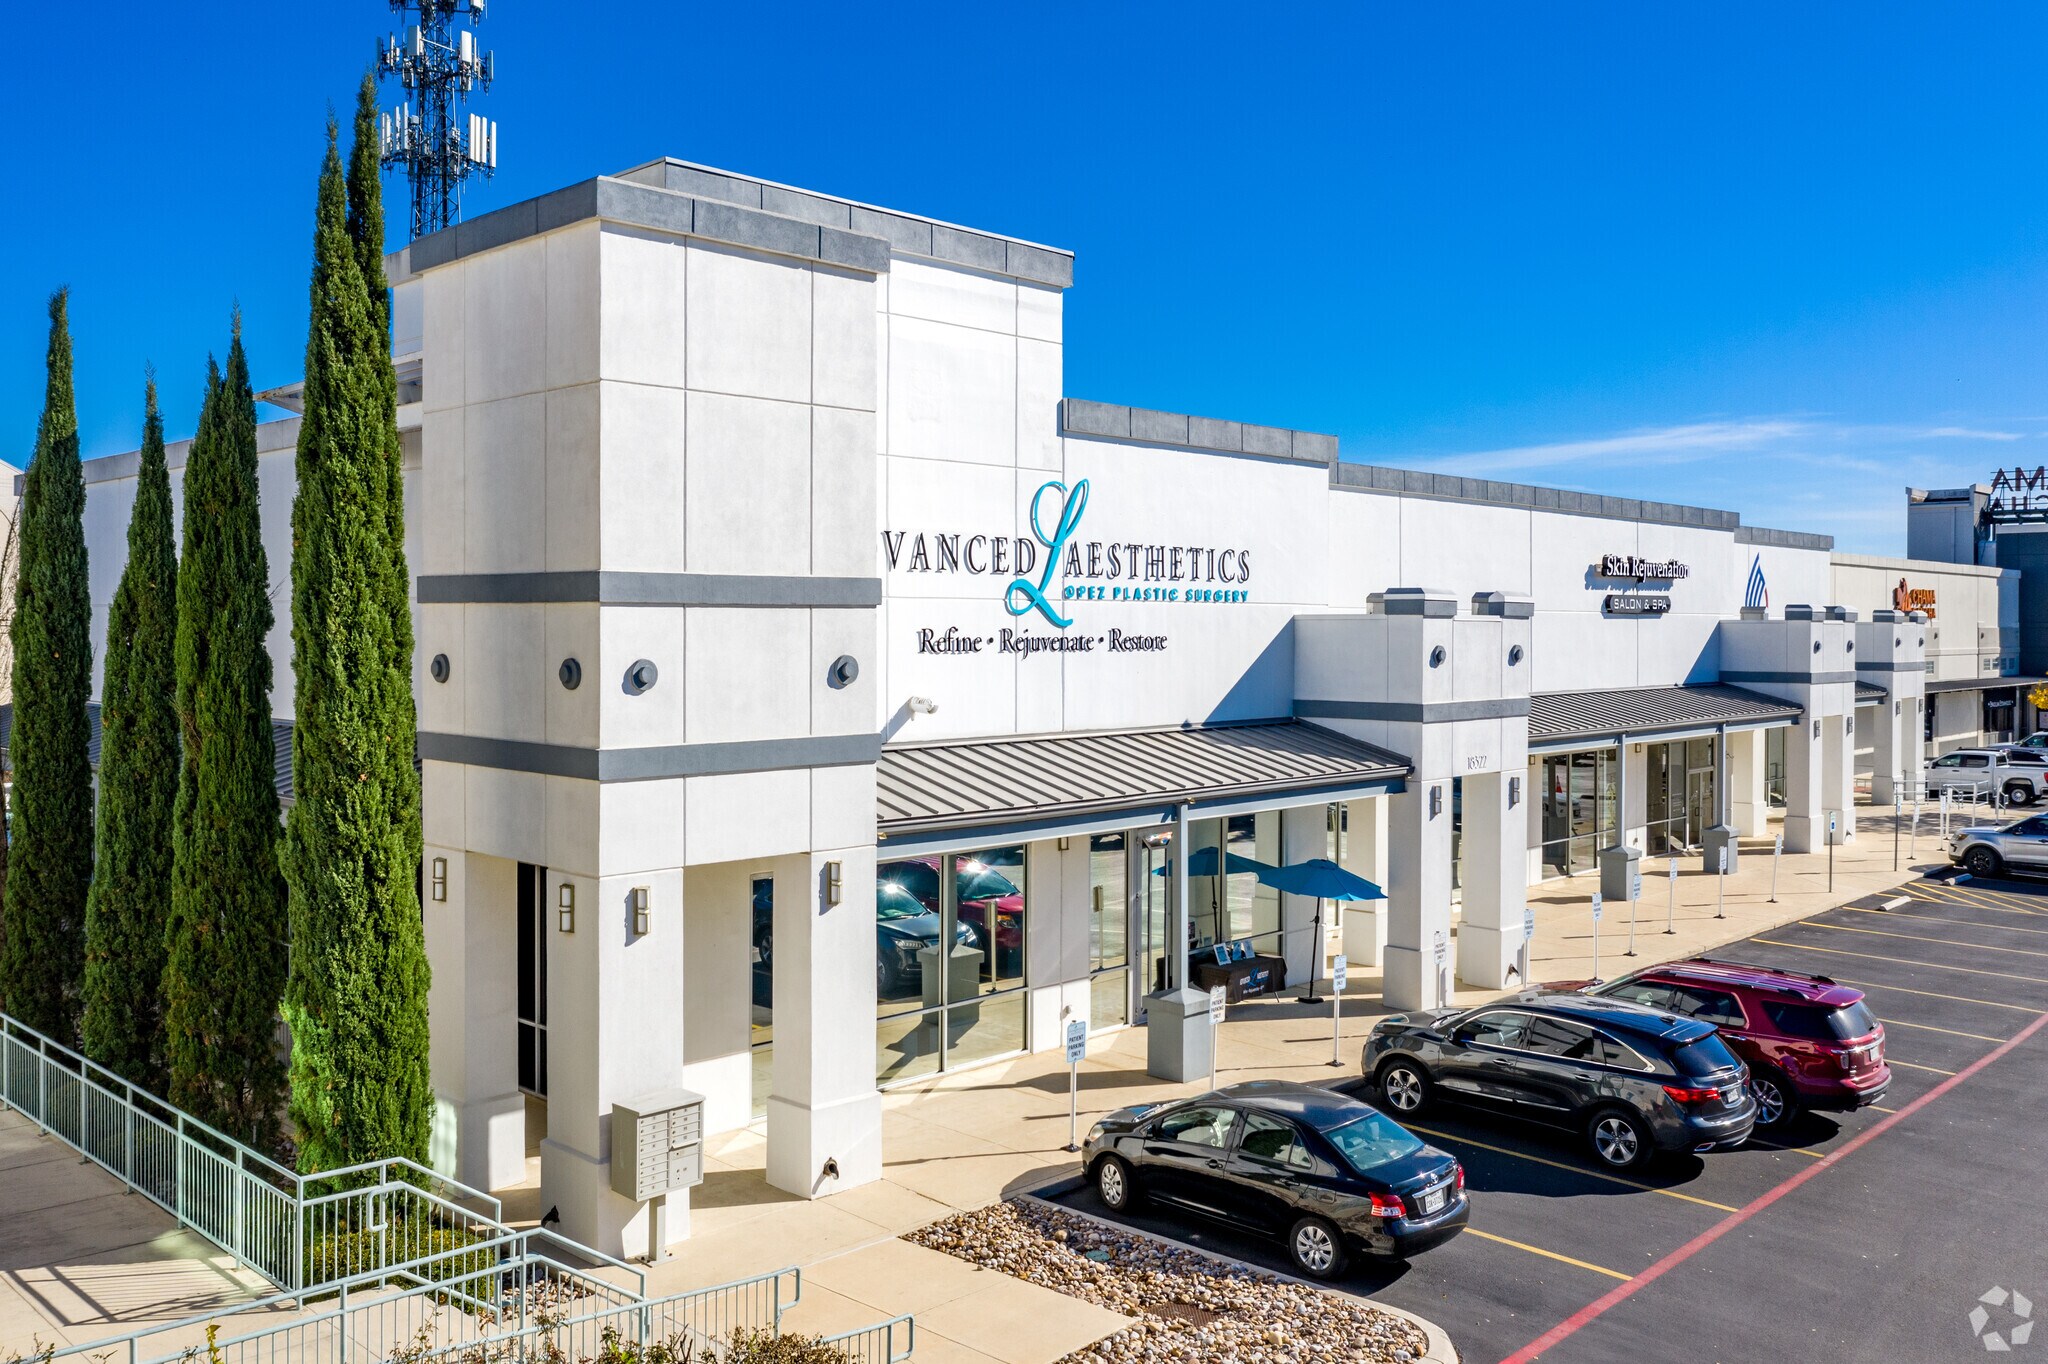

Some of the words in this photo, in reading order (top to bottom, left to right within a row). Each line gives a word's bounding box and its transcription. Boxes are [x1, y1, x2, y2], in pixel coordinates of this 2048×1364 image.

[883, 529, 1037, 575] VANCED
[1064, 540, 1251, 583] AESTHETICS
[1606, 555, 1630, 577] Skin
[1631, 556, 1690, 583] Rejuvenation
[1112, 586, 1180, 602] PLASTIC
[1185, 588, 1250, 603] SURGERY
[1613, 598, 1642, 610] SALON
[1644, 599, 1650, 610] &
[1652, 599, 1668, 610] SPA
[920, 626, 983, 654] Refine
[1001, 628, 1095, 660] Rejuvenate
[1110, 627, 1168, 652] Restore
[1068, 1034, 1084, 1043] PATIENT
[1067, 1041, 1085, 1051] PARKING
[1071, 1050, 1081, 1058] ONLY
